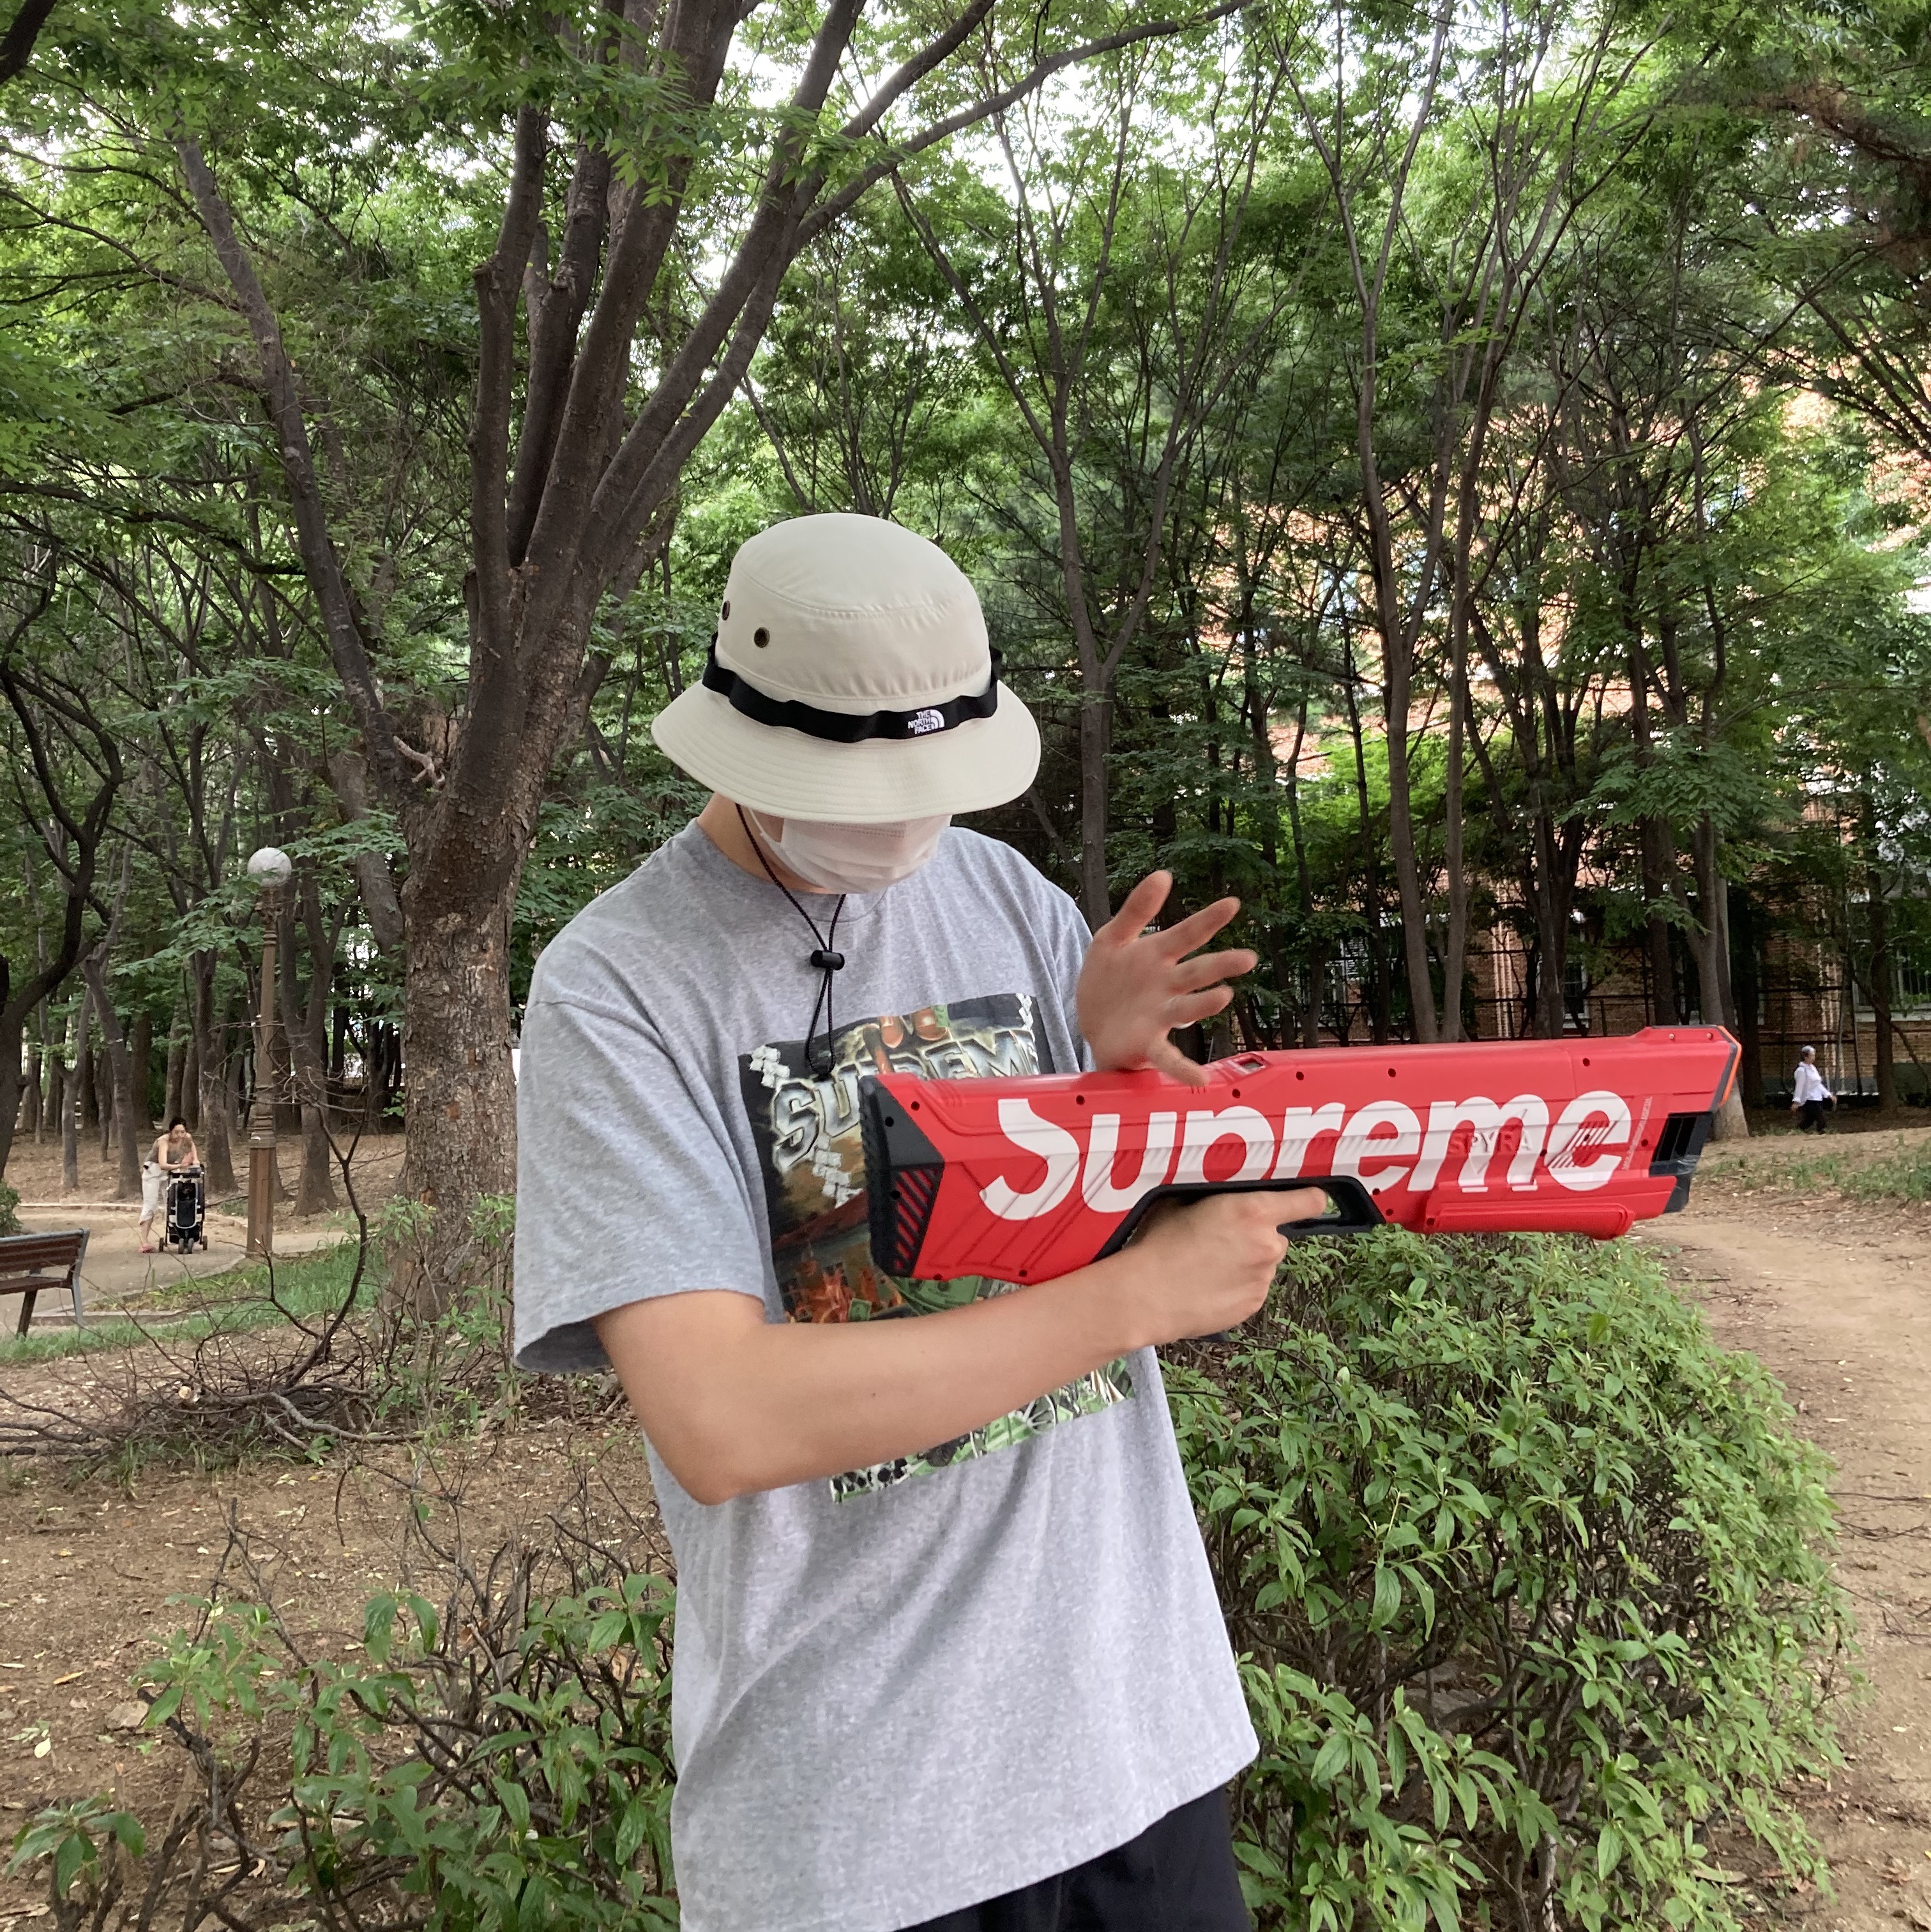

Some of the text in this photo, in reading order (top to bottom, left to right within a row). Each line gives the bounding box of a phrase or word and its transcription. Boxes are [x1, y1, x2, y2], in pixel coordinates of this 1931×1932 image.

[916, 709, 931, 720] THE
[907, 717, 931, 729] NORTH
[914, 724, 932, 734] FACE
[1448, 1129, 1533, 1153] SPYRA
[979, 1090, 1630, 1221] Supreme
